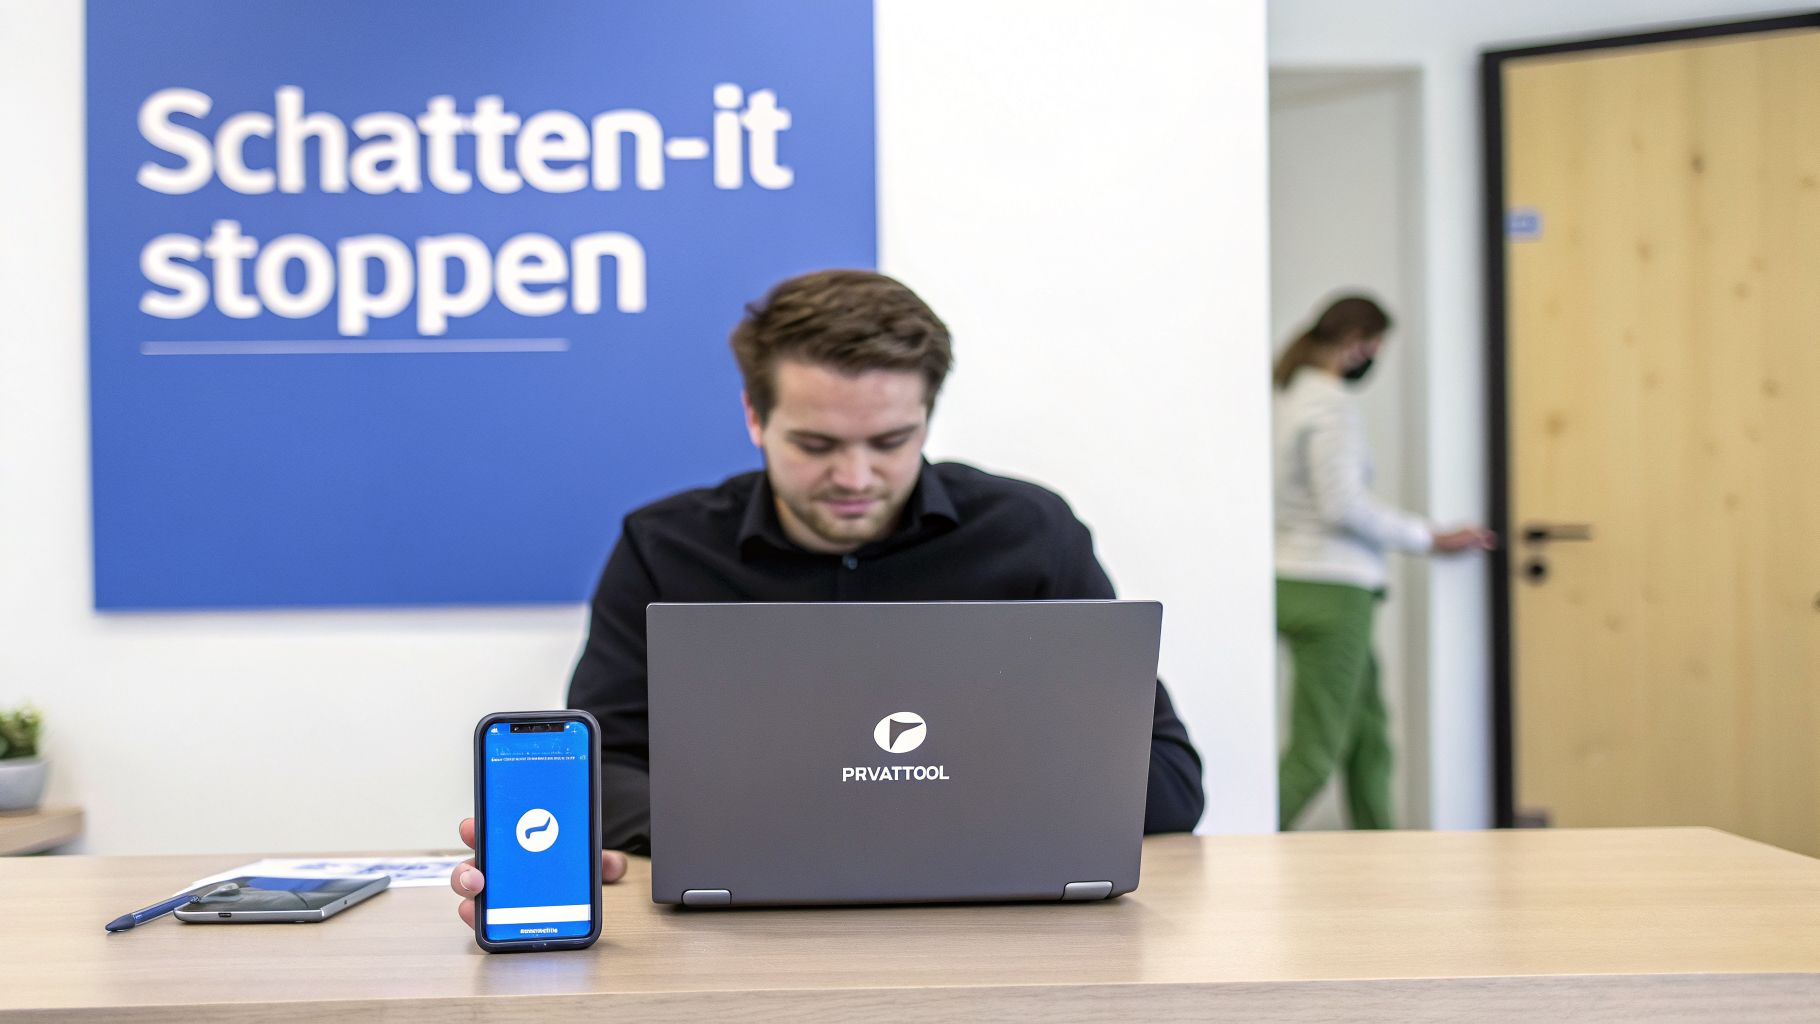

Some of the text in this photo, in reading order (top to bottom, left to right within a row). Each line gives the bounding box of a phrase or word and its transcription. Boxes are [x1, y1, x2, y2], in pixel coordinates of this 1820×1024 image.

[137, 83, 794, 195] Schatten-it
[139, 220, 647, 336] stoppen
[842, 765, 950, 782] PRVATTOOL
